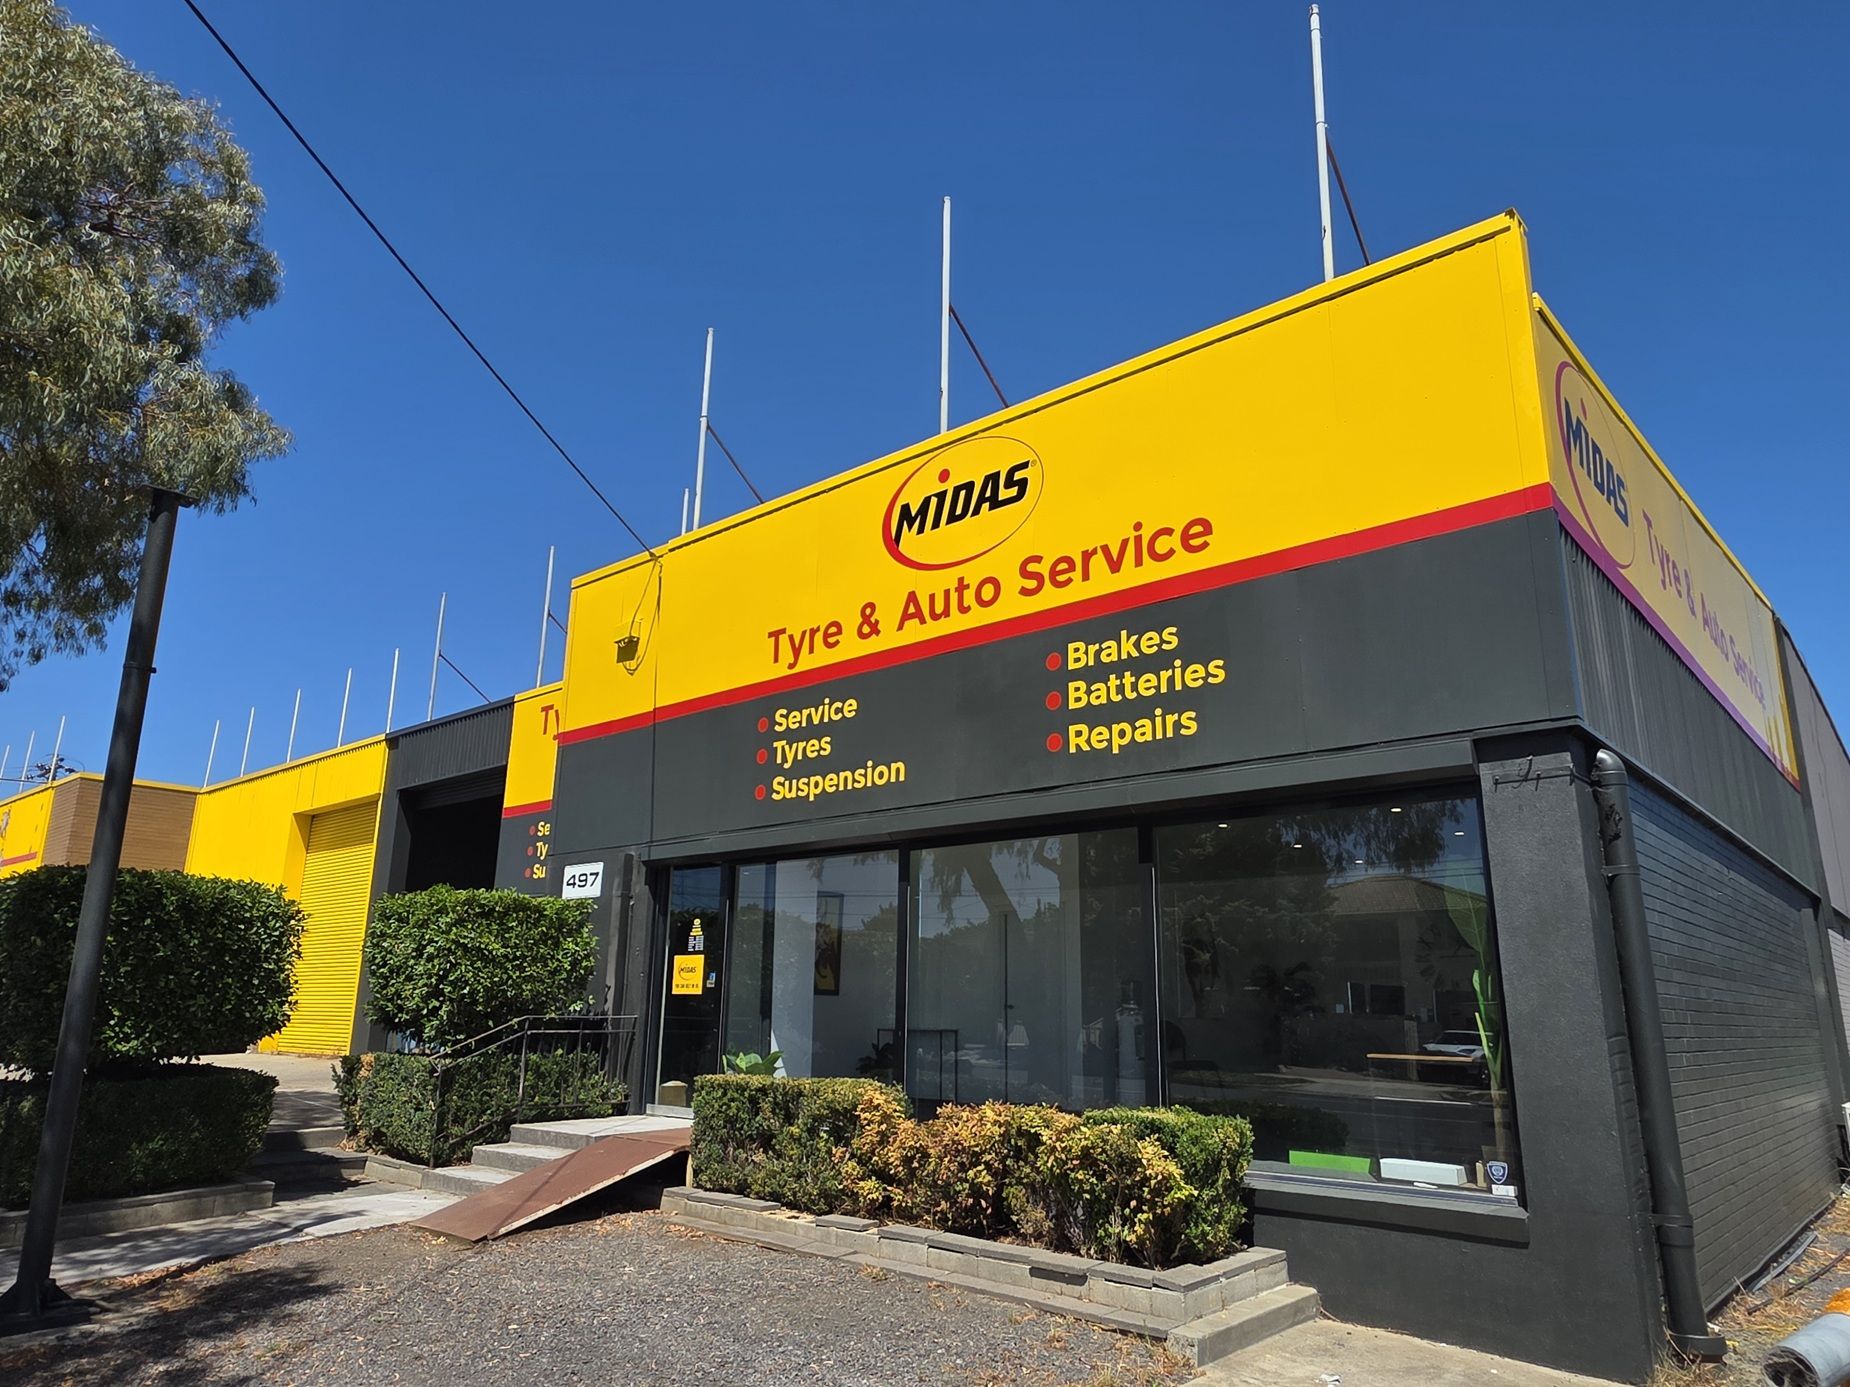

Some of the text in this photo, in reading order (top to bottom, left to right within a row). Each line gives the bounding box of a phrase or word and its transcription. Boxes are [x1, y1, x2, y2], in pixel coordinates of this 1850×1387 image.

[1564, 396, 1629, 528] MIDAS
[893, 459, 1030, 549] MIDAS
[767, 516, 1214, 670] Tyre & Auto Service
[1642, 508, 1682, 599] Tyre
[1684, 567, 1697, 620] &
[1700, 592, 1729, 663] Auto
[1066, 626, 1179, 671] Brakes
[1066, 658, 1226, 710] Batteries
[773, 697, 858, 733] Service
[1068, 708, 1199, 754] Repairs
[773, 733, 832, 766] Tyres
[771, 760, 906, 801] Suspension
[566, 871, 600, 889] 497
